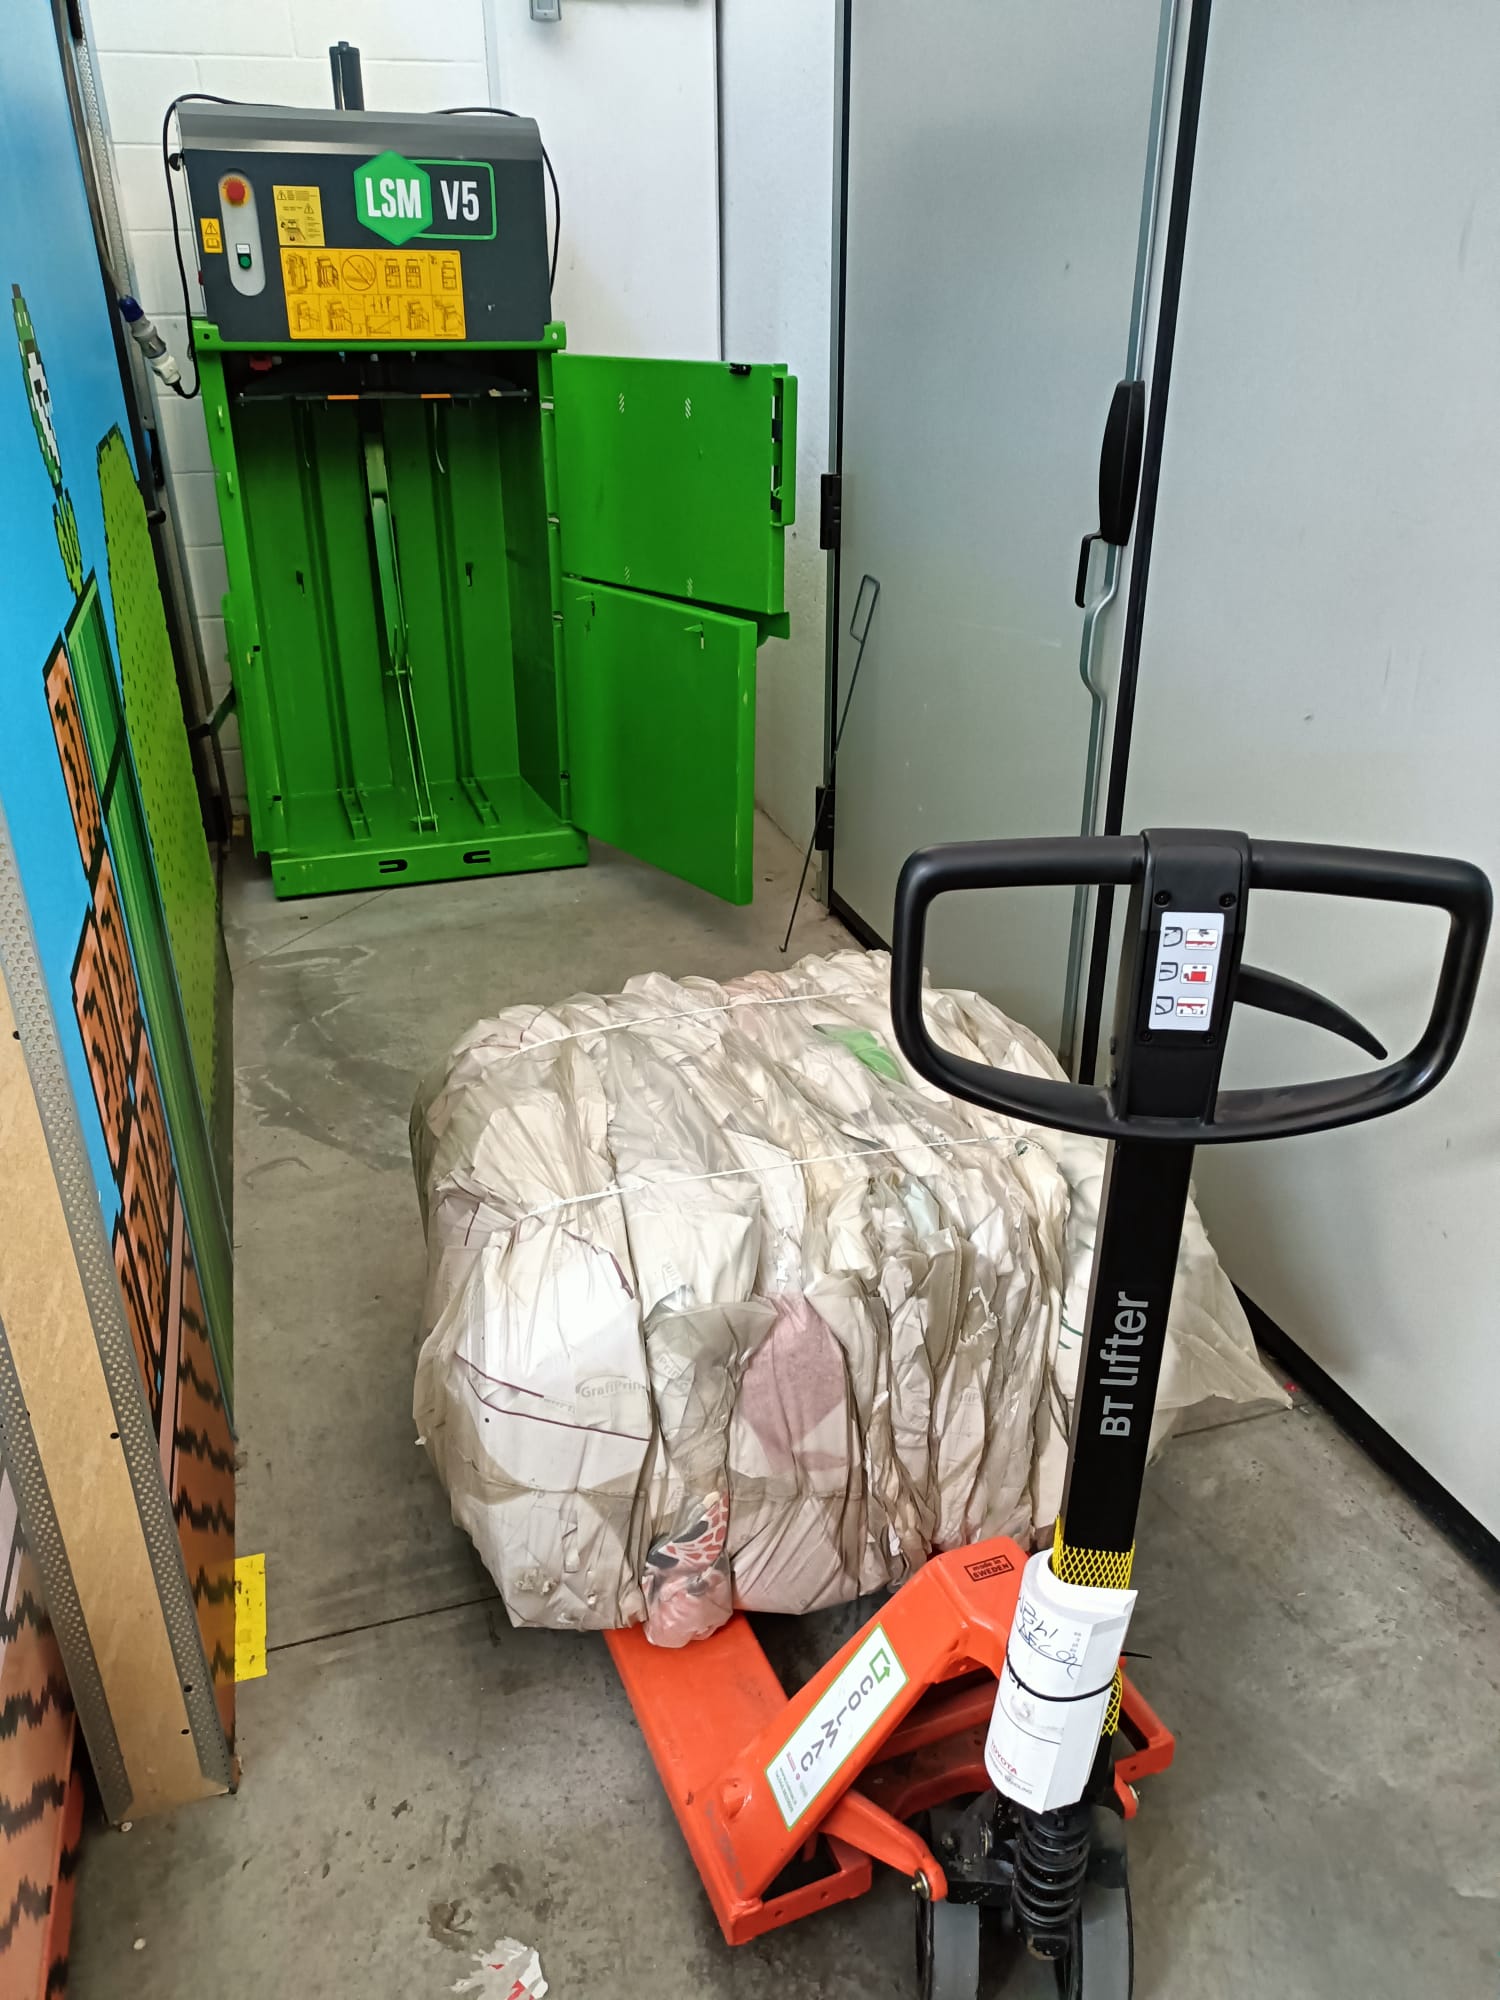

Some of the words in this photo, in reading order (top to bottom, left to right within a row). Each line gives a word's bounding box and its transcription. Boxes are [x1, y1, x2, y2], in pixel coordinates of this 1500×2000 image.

[365, 177, 422, 219] LSM
[440, 180, 480, 221] V5
[1100, 1395, 1134, 1437] BT
[972, 1563, 1010, 1578] SWEDEN
[800, 1675, 875, 1773] COLMAC
